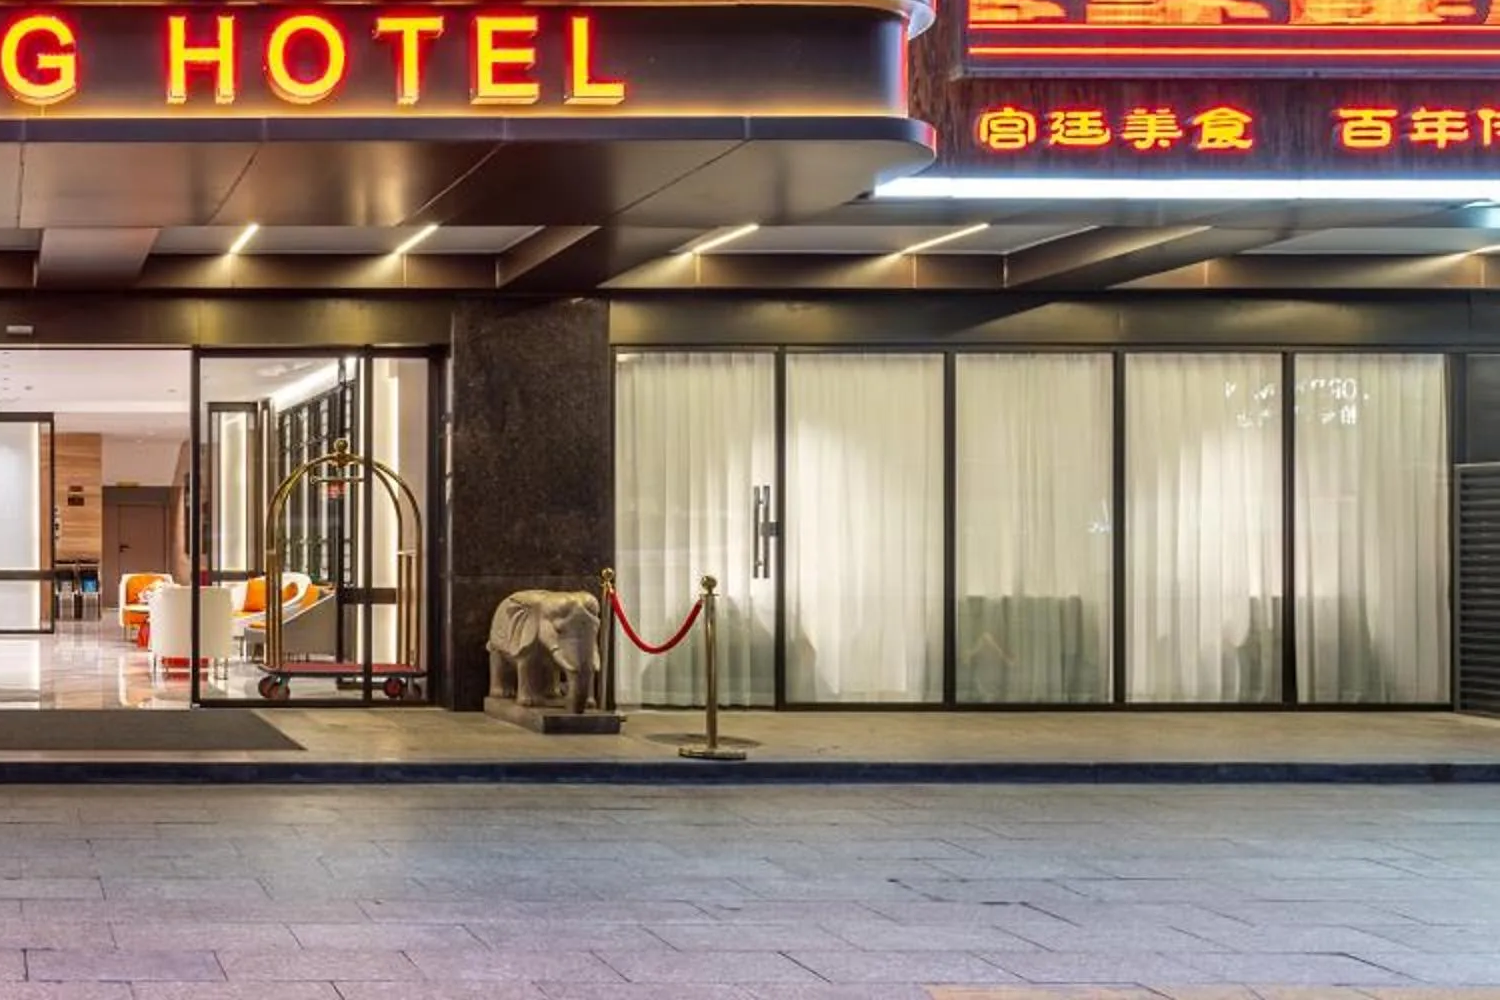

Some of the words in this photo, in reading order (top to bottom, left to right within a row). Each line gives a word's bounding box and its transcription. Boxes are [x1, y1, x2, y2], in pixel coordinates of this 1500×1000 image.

[165, 14, 626, 106] HOTEL
[979, 107, 1253, 149] 宫廷美食
